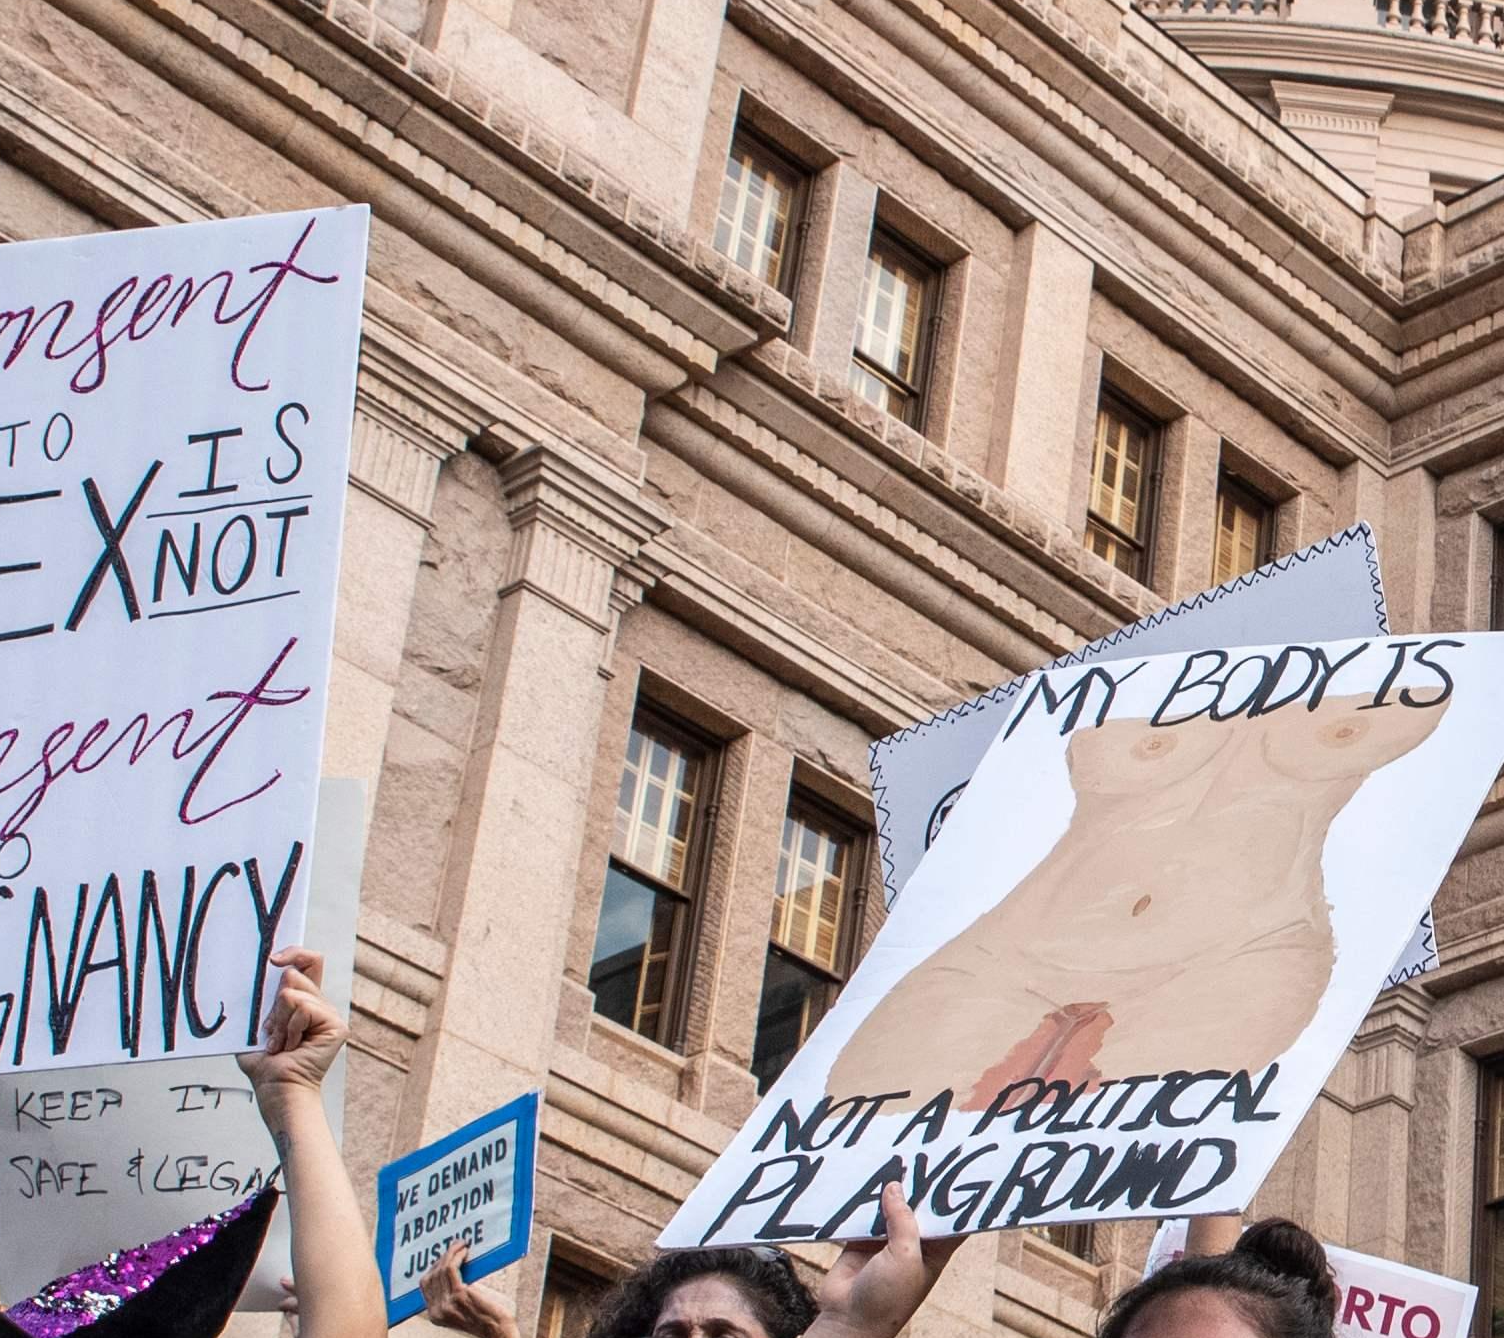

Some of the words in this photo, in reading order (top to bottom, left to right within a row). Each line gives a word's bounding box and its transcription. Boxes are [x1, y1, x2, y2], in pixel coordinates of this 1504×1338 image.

[178, 402, 310, 499] IS
[151, 506, 309, 603] NOT
[1003, 661, 1148, 743] MY
[1150, 642, 1370, 728] BODY
[1356, 640, 1465, 709] IS
[15, 1085, 123, 1129] KEEP
[753, 1089, 910, 1154] NOT
[894, 1085, 962, 1149] A
[970, 1063, 1282, 1138] POLITICAL
[11, 1153, 107, 1199] SAFE
[400, 1179, 494, 1247] ABORTION
[428, 1138, 507, 1197] DEMAND
[701, 1137, 1238, 1246] PLAYGROUND
